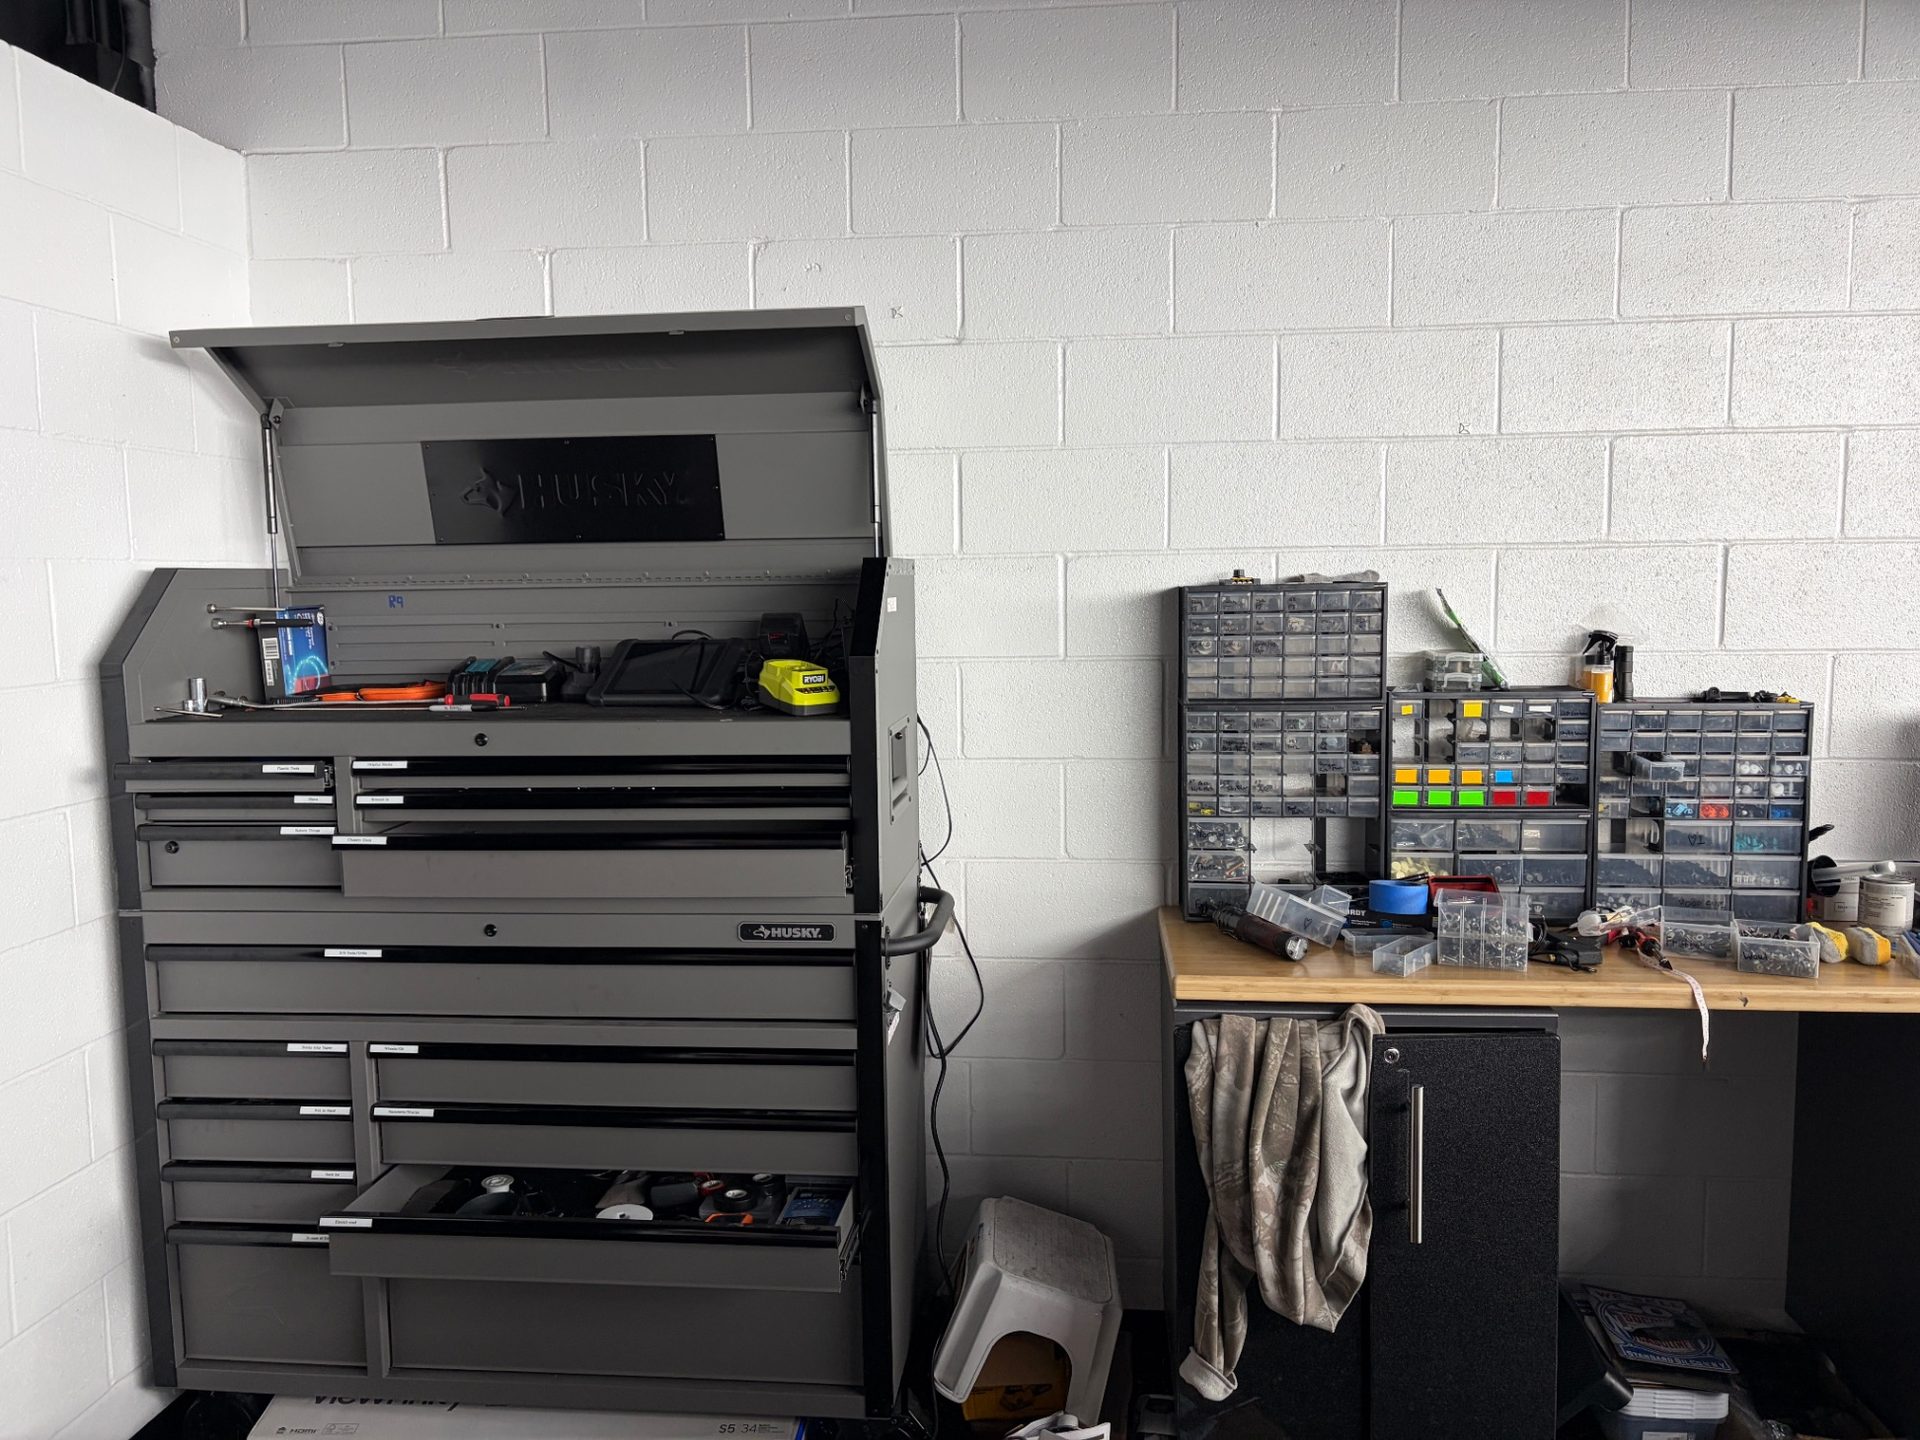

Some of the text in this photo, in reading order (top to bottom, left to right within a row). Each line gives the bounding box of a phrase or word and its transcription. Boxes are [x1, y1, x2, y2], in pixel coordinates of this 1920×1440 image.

[517, 472, 678, 510] HUSKY
[803, 675, 824, 683] RYOBI
[718, 1423, 735, 1433] S5
[741, 1423, 757, 1433] 34
